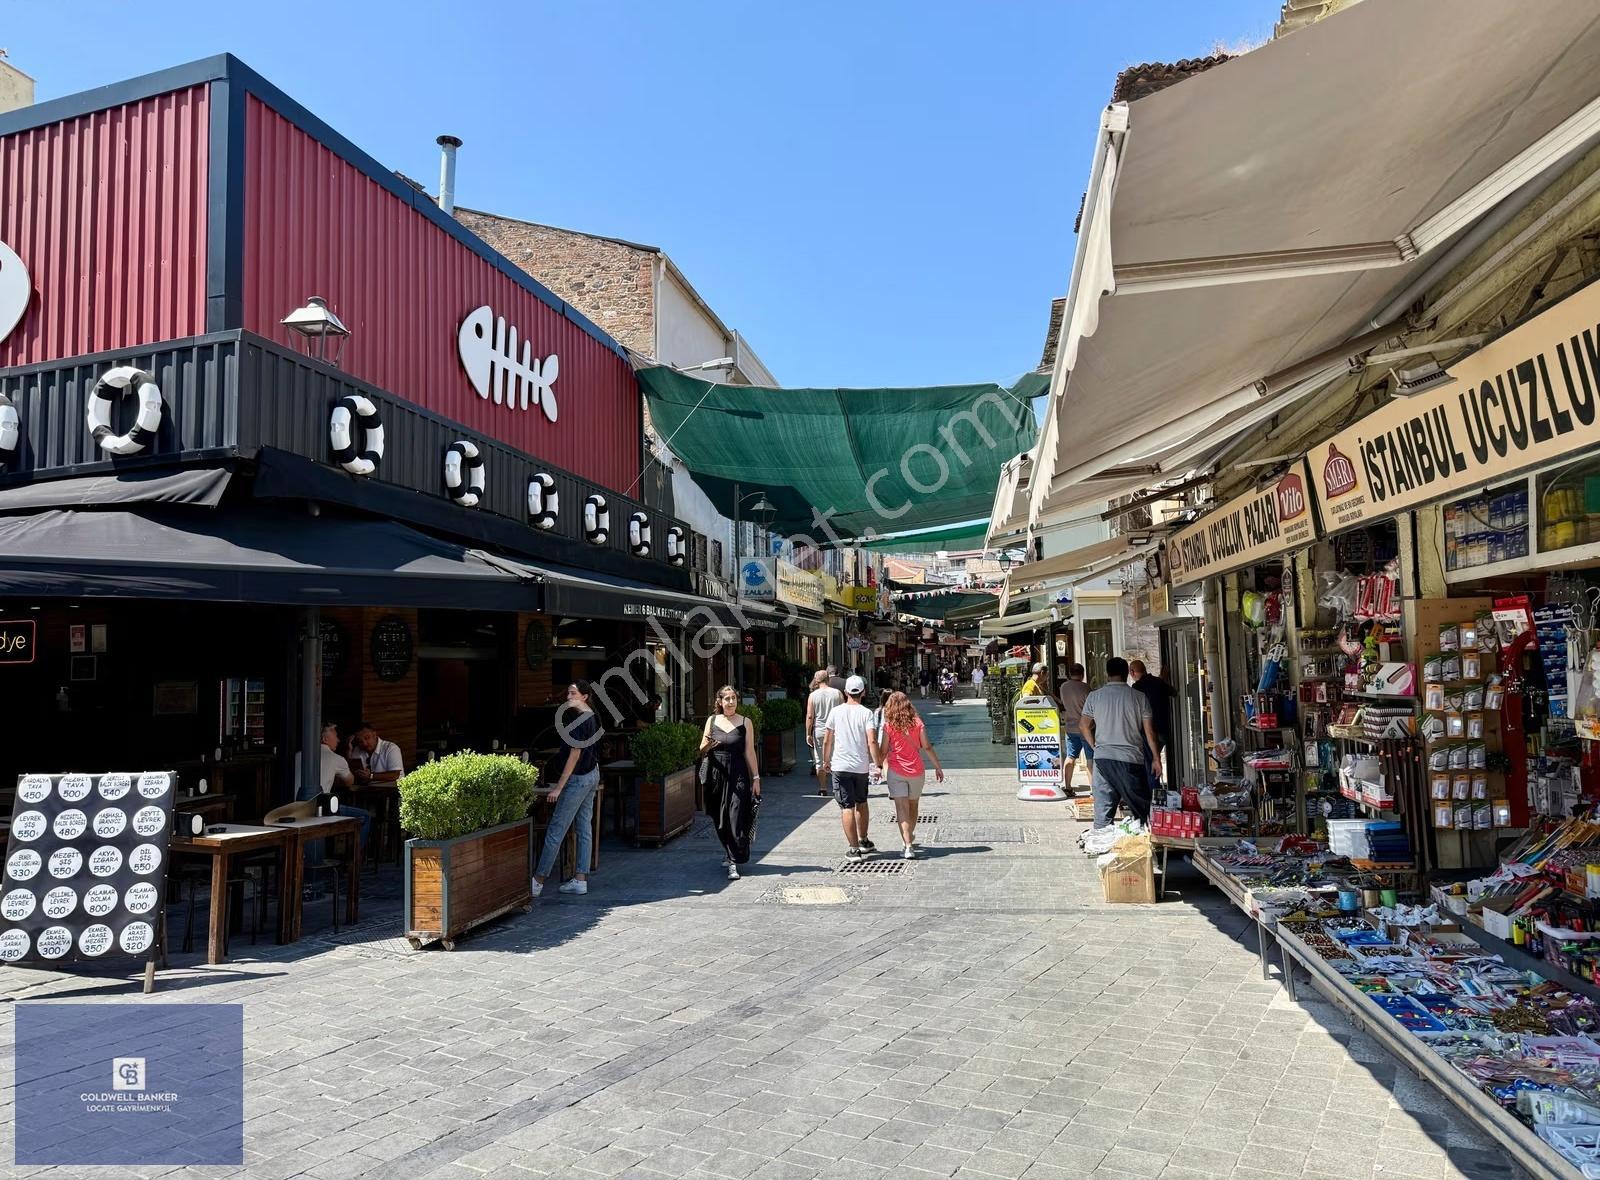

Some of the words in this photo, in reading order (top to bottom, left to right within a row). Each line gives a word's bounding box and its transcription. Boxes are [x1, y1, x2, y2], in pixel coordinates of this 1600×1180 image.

[1358, 404, 1467, 502] İSTANBUL
[1458, 323, 1600, 464] UCUZLU
[1280, 487, 1303, 516] Vilo
[1180, 529, 1210, 573] İSTANBUL
[1208, 510, 1245, 561] UCUZLUK
[1244, 492, 1280, 547] PAZARI
[1022, 769, 1059, 777] BULUNUR
